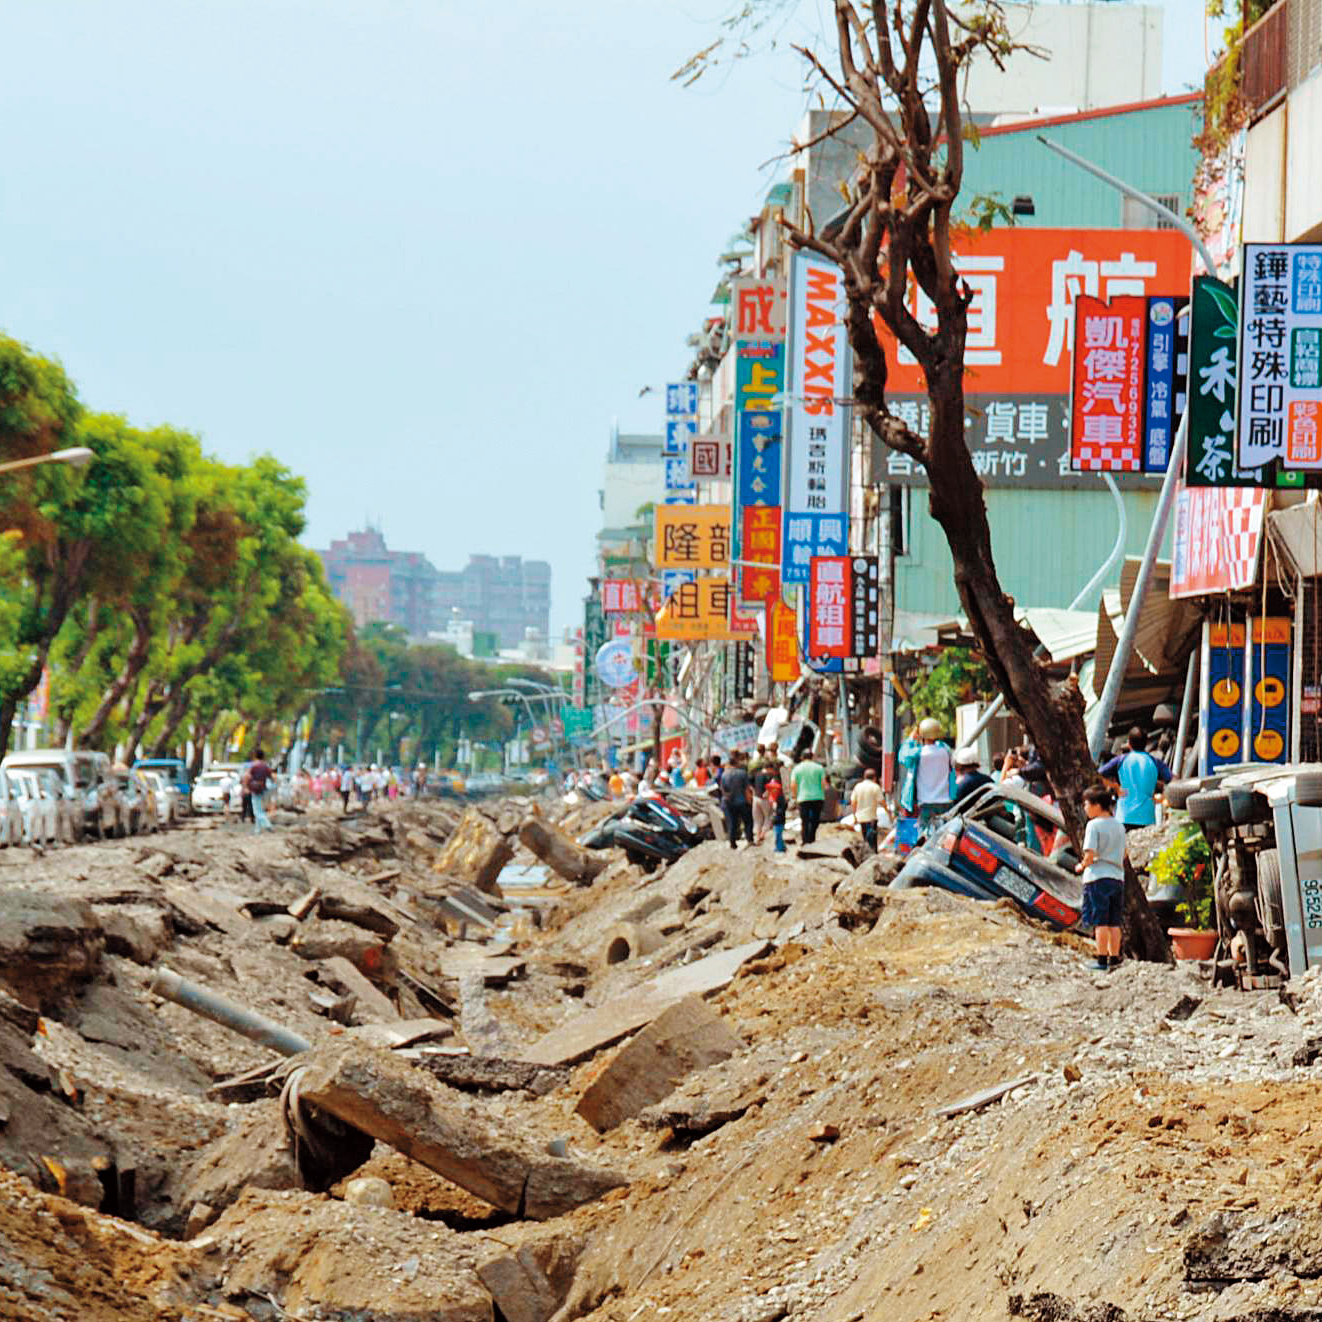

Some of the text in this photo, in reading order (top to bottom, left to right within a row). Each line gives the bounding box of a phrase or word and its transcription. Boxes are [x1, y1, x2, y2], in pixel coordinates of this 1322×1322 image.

[738, 285, 787, 333] 成
[1296, 255, 1322, 313] 特殊印刷
[804, 268, 837, 416] MAXXIS
[1082, 316, 1128, 446] 凱傑汽車
[985, 401, 1049, 444] 貨車
[1291, 401, 1319, 460] 彩色印刷
[816, 560, 845, 647] 直航租車
